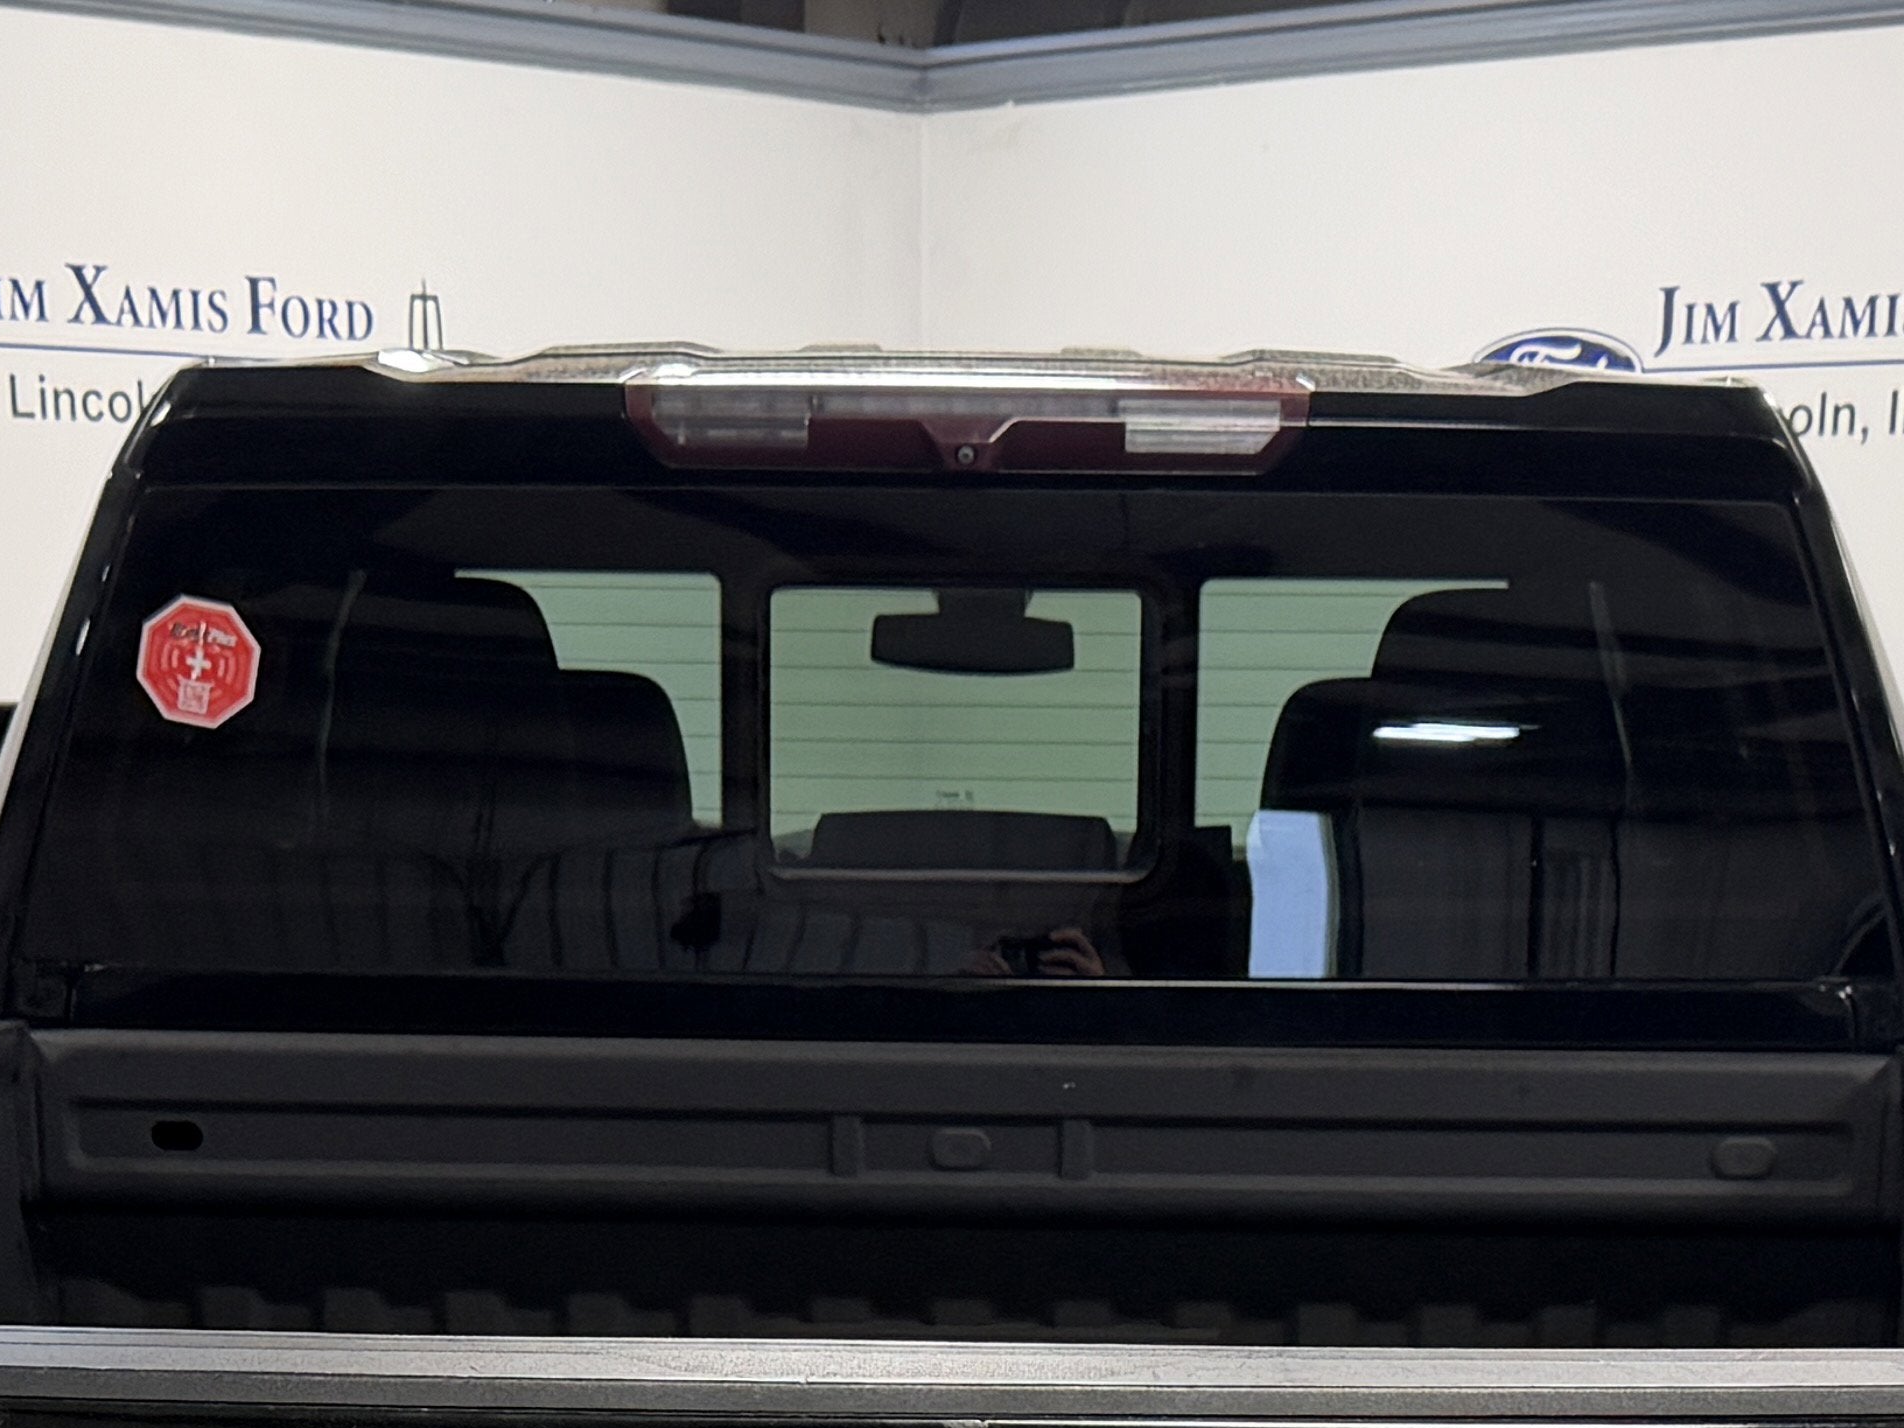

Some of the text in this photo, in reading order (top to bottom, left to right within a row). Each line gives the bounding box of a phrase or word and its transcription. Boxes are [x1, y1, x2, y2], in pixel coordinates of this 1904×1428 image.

[66, 263, 228, 332] XAMIS
[246, 276, 373, 341] FORD
[1655, 287, 1739, 357] JIM
[1787, 391, 1868, 445] oln,
